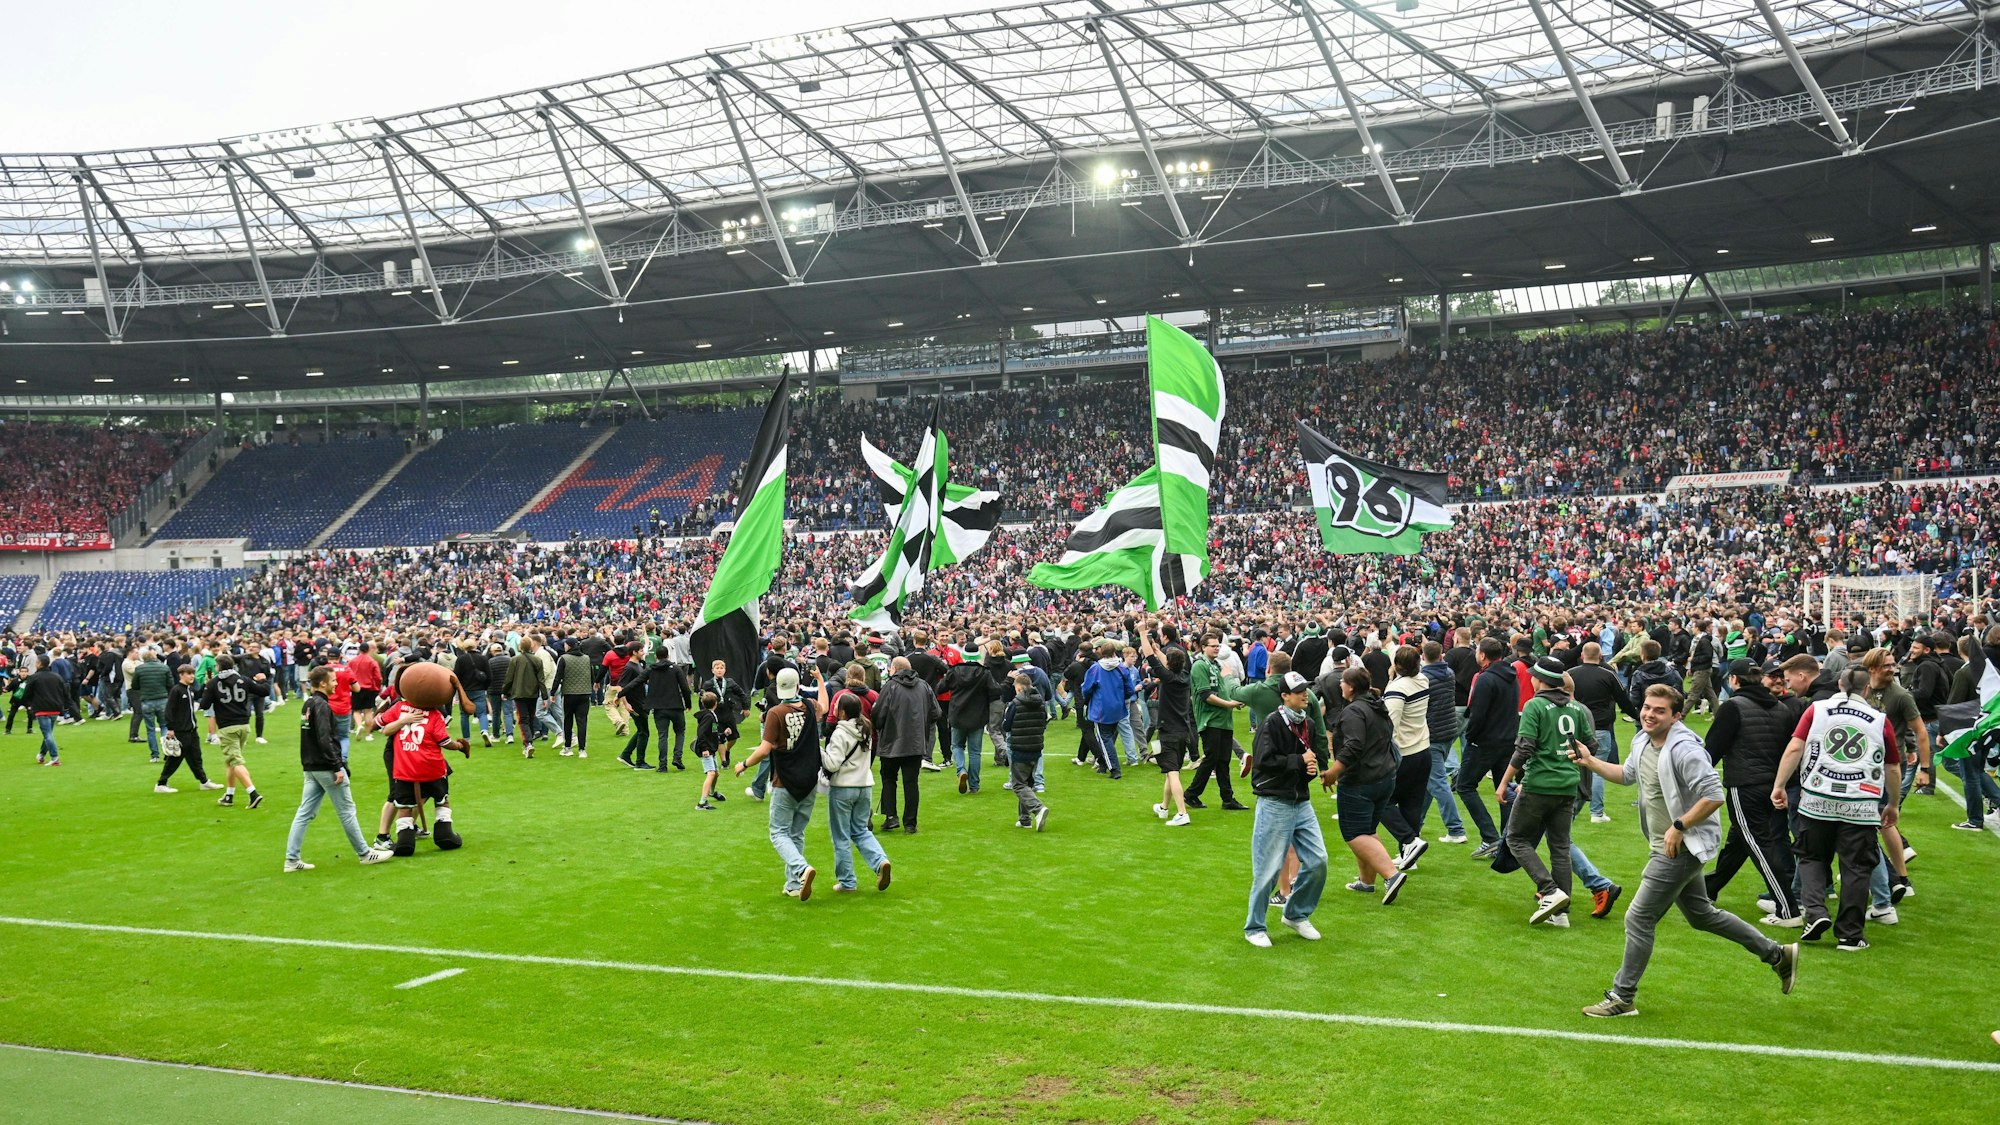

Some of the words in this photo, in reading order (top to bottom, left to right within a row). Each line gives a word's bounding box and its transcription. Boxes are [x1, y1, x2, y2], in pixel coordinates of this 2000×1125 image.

[1740, 472, 1785, 480] HEIDEN
[1326, 462, 1403, 523] 96
[1558, 714, 1576, 747] 9
[1826, 728, 1866, 760] 96
[1805, 799, 1875, 814] ANNOVE
